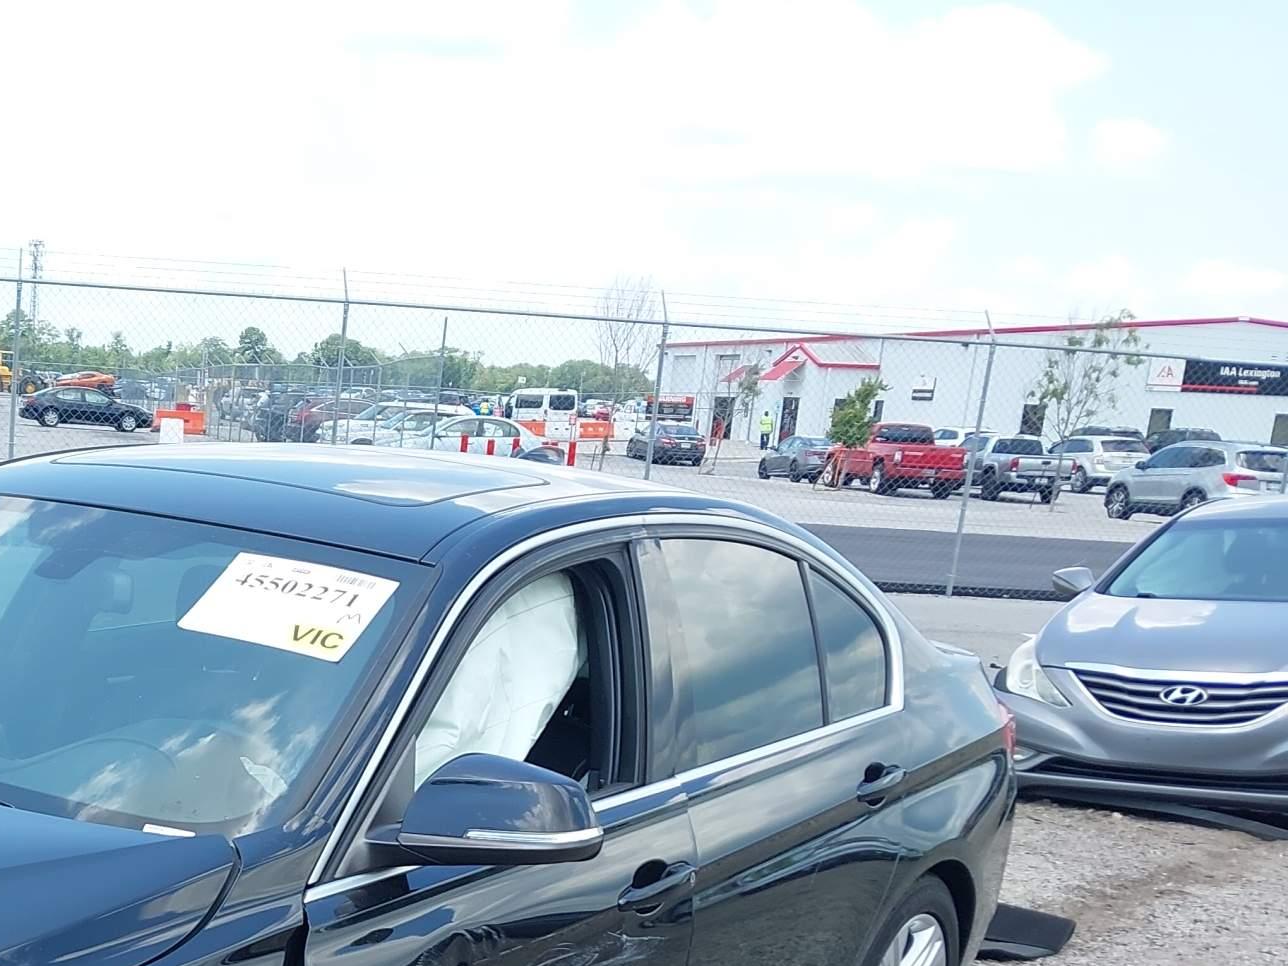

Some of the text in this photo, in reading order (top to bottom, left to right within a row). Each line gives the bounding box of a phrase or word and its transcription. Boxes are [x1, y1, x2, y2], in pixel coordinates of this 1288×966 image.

[1219, 366, 1281, 380] IAA Lexington
[236, 573, 359, 607] 45502271
[292, 624, 344, 649] VIC
